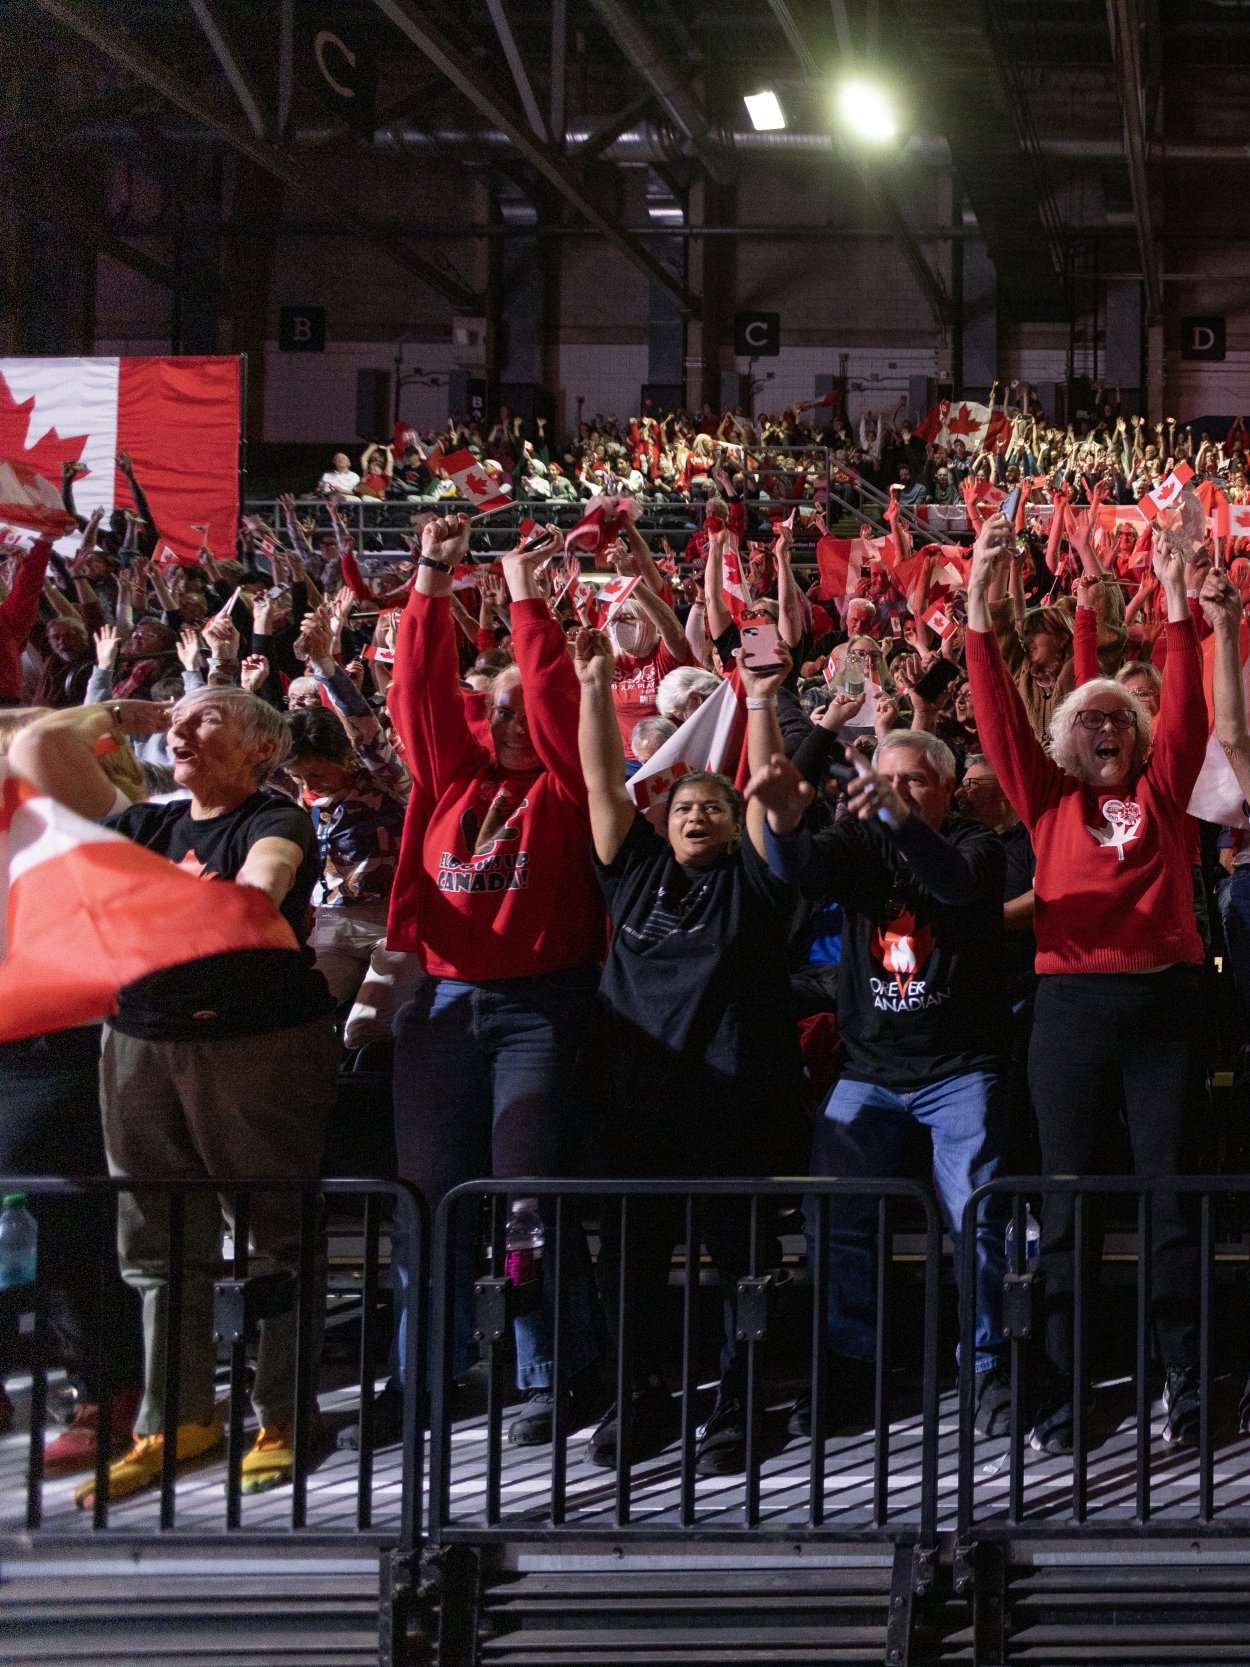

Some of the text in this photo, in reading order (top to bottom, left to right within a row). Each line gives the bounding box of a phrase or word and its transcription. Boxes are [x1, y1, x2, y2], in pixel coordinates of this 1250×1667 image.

[315, 31, 355, 97] C
[293, 317, 311, 340] B
[745, 322, 768, 346] C
[1192, 327, 1215, 350] D
[472, 396, 482, 408] B
[504, 851, 529, 868] UP
[437, 868, 529, 893] CANADA!
[870, 977, 926, 999] OREVER
[874, 987, 951, 1013] ANADIAN
